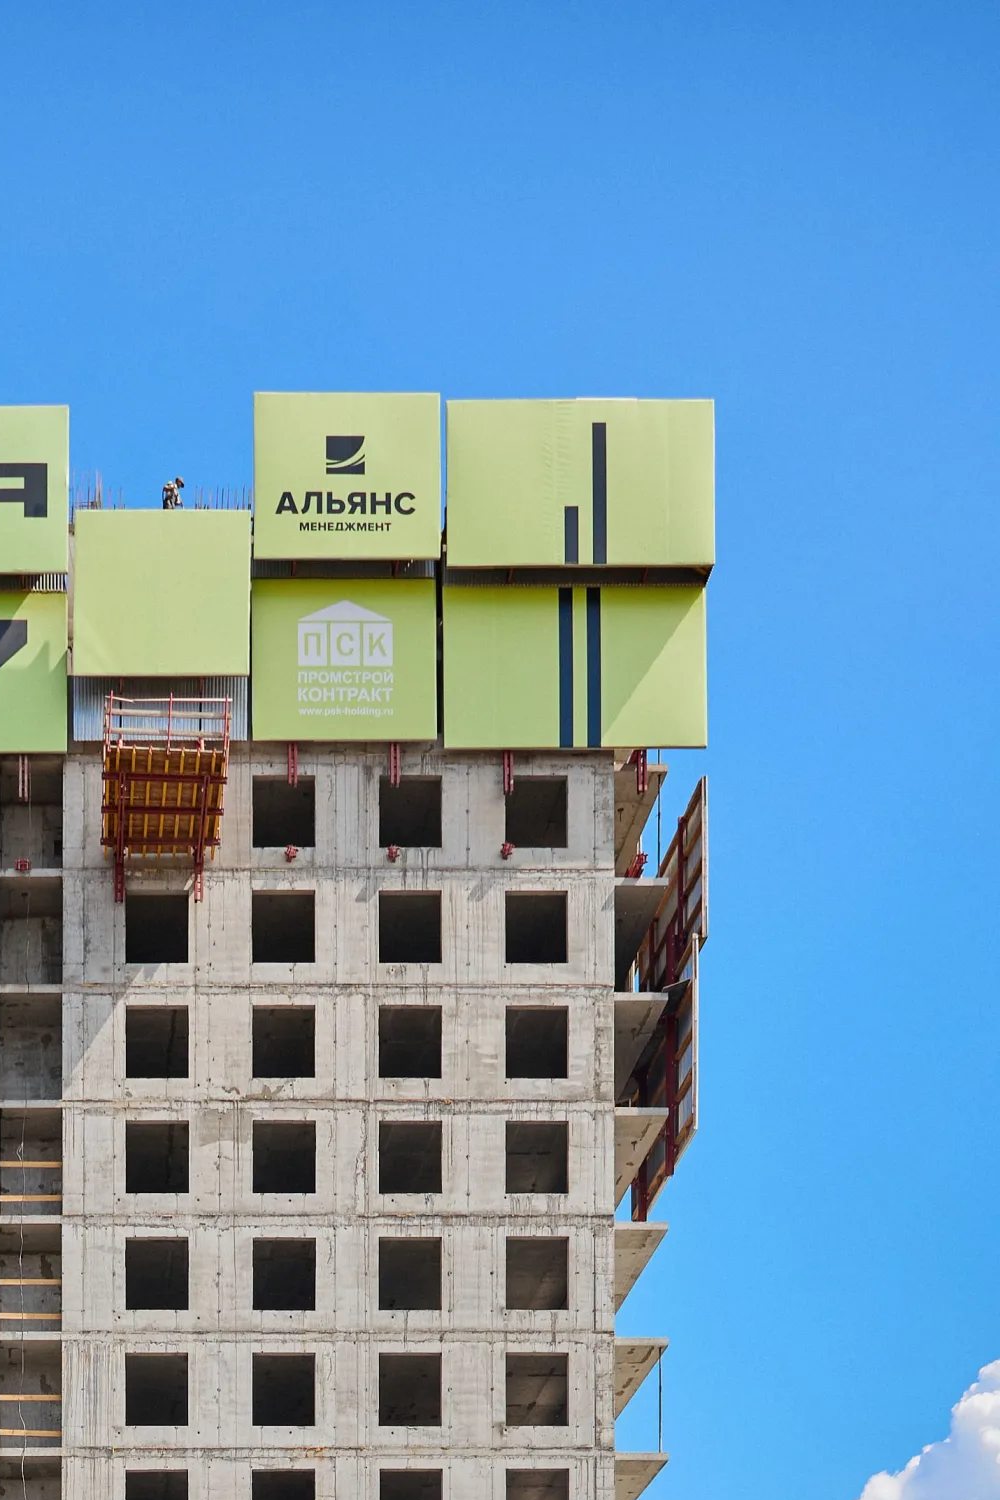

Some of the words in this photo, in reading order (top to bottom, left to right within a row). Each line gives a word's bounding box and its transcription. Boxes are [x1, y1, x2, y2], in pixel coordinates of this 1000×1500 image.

[275, 491, 416, 516] АЛЬЯНС
[299, 521, 392, 532] МЕНЕДЖМЕНТ
[303, 632, 388, 658] ПСК
[297, 668, 394, 684] ПРОМСТРОЙ
[297, 687, 394, 702] КОНТРАКТ
[298, 706, 394, 718] www.psk-holding.ru
